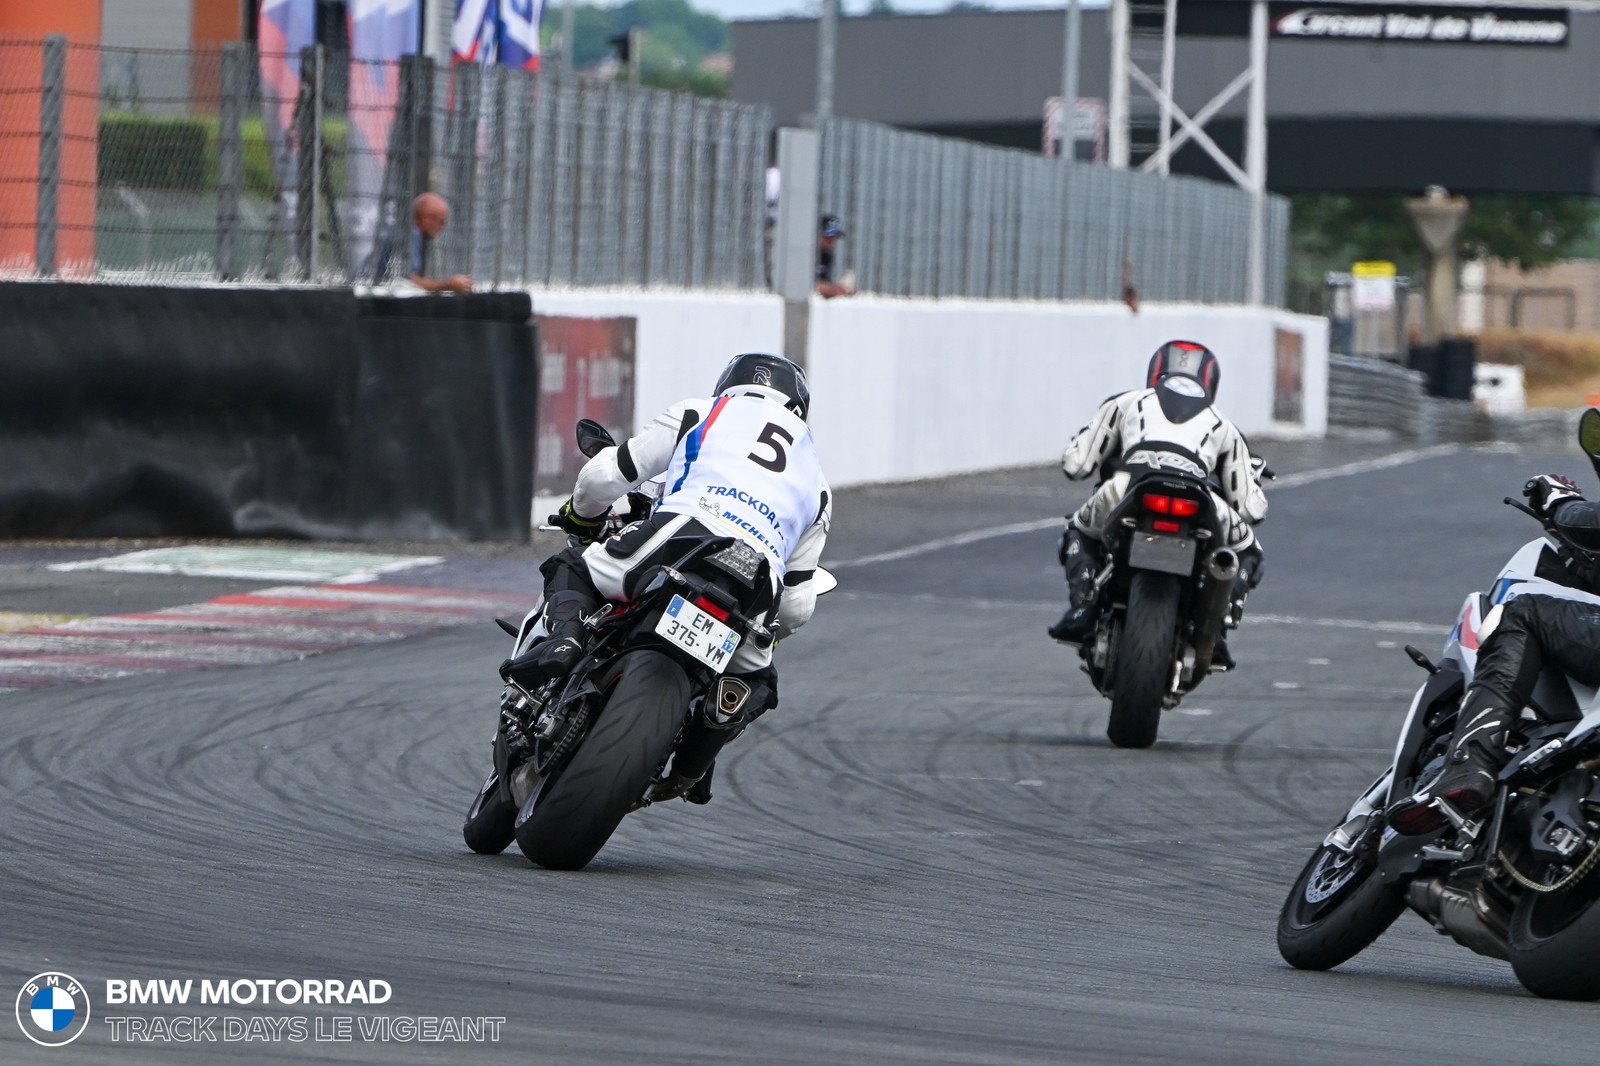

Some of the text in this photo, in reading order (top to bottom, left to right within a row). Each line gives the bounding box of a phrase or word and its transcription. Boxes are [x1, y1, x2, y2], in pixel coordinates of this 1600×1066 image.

[747, 421, 795, 473] 5
[691, 612, 715, 635] EM
[705, 642, 726, 665] YM
[723, 641, 735, 652] 17
